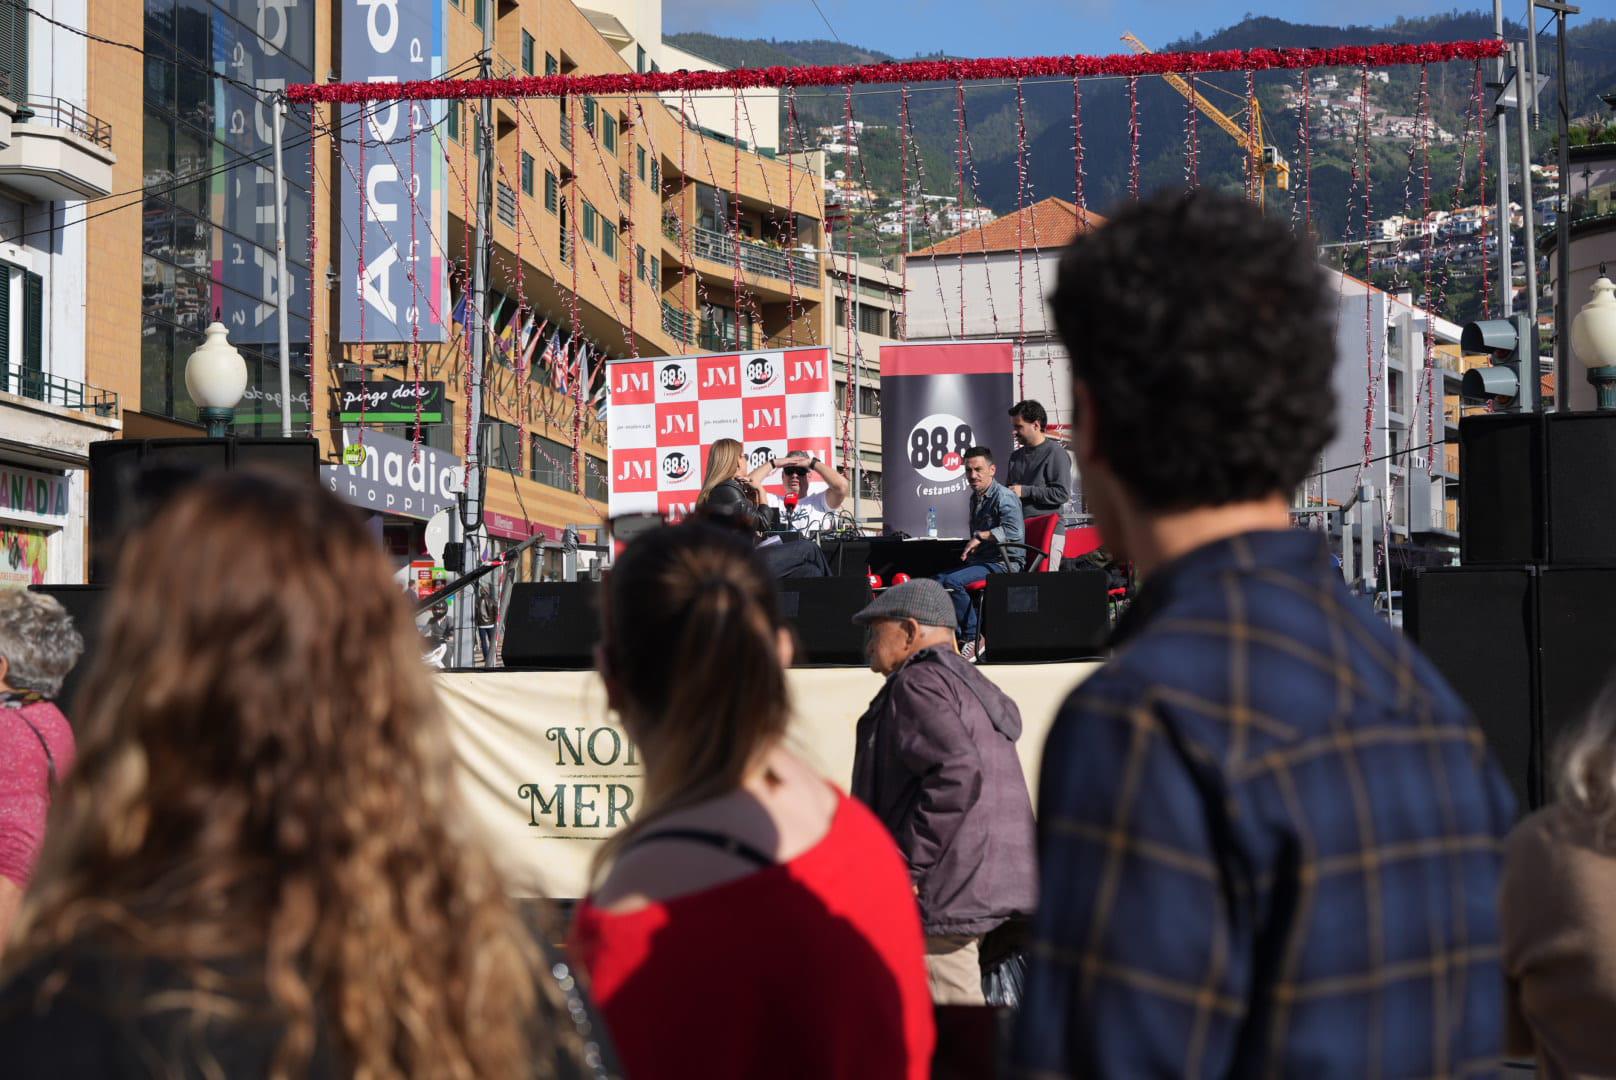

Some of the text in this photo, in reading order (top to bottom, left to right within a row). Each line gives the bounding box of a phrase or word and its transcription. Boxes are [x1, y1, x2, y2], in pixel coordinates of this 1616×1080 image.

[616, 371, 649, 393] JM
[702, 366, 737, 388] JM
[789, 360, 824, 382] JM
[660, 413, 695, 435] JM
[747, 407, 782, 429] JM
[617, 460, 653, 481] JM
[945, 457, 960, 467] JM
